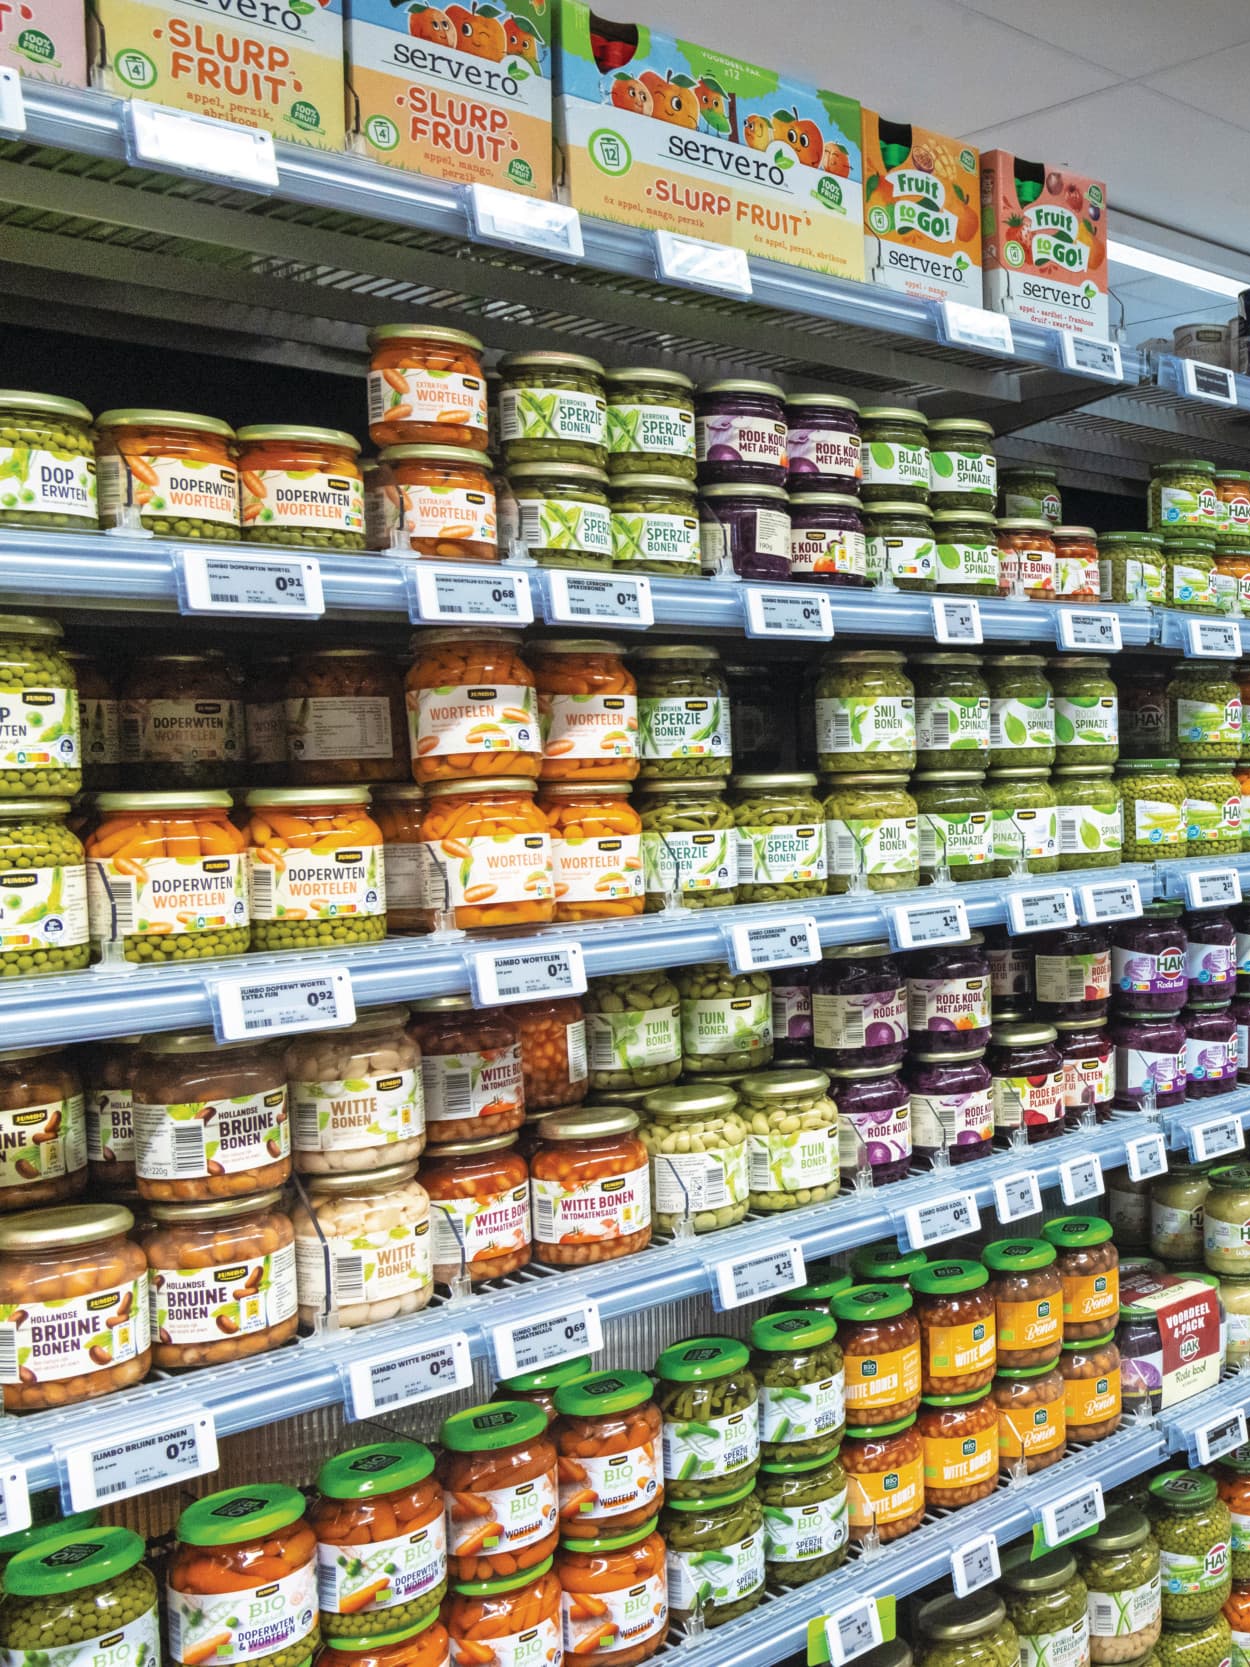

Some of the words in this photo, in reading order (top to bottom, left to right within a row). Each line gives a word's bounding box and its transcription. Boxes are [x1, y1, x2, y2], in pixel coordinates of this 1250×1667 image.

[169, 18, 290, 73] SLURP
[394, 43, 518, 96] servero
[171, 53, 286, 104] FRUIT
[186, 91, 225, 109] appel,
[230, 102, 274, 121] perzik,
[409, 87, 508, 133] SLURP
[411, 117, 505, 162] FRUIT
[669, 136, 784, 186] servero
[897, 173, 938, 199] Fruit
[656, 179, 731, 216] SLURP
[736, 201, 802, 236] FRUIT
[917, 212, 950, 237] GO!
[1035, 208, 1073, 231] Fruit
[1052, 243, 1083, 267] GO!
[889, 250, 963, 282] servero
[1023, 281, 1091, 310] servero
[416, 389, 474, 407] WORTELEN
[559, 406, 602, 425] SPERZIE
[560, 420, 591, 434] BONEN
[642, 420, 687, 438] SPERZIE
[643, 434, 674, 447] BONEN
[738, 429, 762, 445] RODE
[763, 432, 785, 449] KOOL
[816, 441, 837, 457] RODE
[839, 445, 861, 460] KOOL
[898, 450, 923, 465] BLAD
[957, 458, 983, 473] BLAD
[41, 465, 74, 486] DOP
[957, 470, 991, 486] SPINAZIE
[41, 483, 87, 502] ERWTEN
[169, 477, 236, 499] DOPERWTEN
[170, 490, 232, 513] WORTELEN
[276, 488, 350, 507] DOPERWTEN
[276, 502, 342, 519] WORTELEN
[419, 505, 478, 522] WORTELEN
[647, 527, 691, 544] SPERZIE
[647, 540, 678, 553] BONEN
[964, 550, 988, 564] BLAD
[964, 561, 996, 576] SPINAZIE
[430, 704, 495, 721] WORTELEN
[566, 711, 623, 727] WORTELEN
[654, 712, 701, 726] SPERZIE
[874, 705, 896, 719] SNIJ
[960, 707, 982, 719] BLAD
[153, 717, 224, 729] DOPERWTEN
[654, 725, 686, 737] BONEN
[874, 717, 903, 730] BONEN
[1075, 718, 1109, 729] SPINAZIE
[948, 823, 975, 837] BLAD
[767, 838, 809, 852] SPERZIE
[948, 833, 983, 847] SPINAZIE
[487, 852, 543, 869] WORTELEN
[659, 846, 708, 859] SPERZIE
[768, 852, 797, 863] BONEN
[560, 855, 620, 870] WORTELEN
[288, 866, 365, 882] DOPERWTEN
[152, 876, 233, 893] DOPERWTEN
[289, 882, 357, 897] WORTELEN
[153, 892, 225, 909] WORTELEN
[494, 958, 519, 968] JUMBO
[521, 954, 560, 966] WORTELEN
[936, 993, 959, 1006] RODE
[960, 992, 982, 1003] KOOL
[698, 1011, 726, 1025] TUIN
[646, 1020, 670, 1035] TUIN
[698, 1023, 728, 1036] BONEN
[646, 1032, 672, 1047] BONEN
[218, 1106, 259, 1120] HOLLANDSE
[330, 1097, 377, 1115] WITTE
[219, 1112, 273, 1138] BRUINE
[332, 1113, 372, 1129] BONEN
[220, 1132, 261, 1151] BONEN
[800, 1141, 825, 1158] TUIN
[801, 1155, 827, 1169] BONEN
[560, 1195, 596, 1212] WITTE
[599, 1190, 634, 1208] BONEN
[377, 1244, 416, 1266] WITTE
[217, 1268, 246, 1280] JUMBO
[377, 1261, 412, 1279] BONEN
[166, 1280, 206, 1289] HOLLANDSE
[167, 1287, 227, 1307] BRUINE
[30, 1310, 78, 1324] HOLLANDSE
[168, 1306, 208, 1321] BONEN
[1166, 1302, 1211, 1329] VOORDEEL
[31, 1315, 101, 1343] BRUINE
[1173, 1318, 1205, 1339] 4-PACK
[32, 1338, 81, 1358] BONEN
[1180, 1337, 1200, 1356] HAK
[371, 1364, 396, 1376] JUMBO
[398, 1357, 416, 1369] WITTE
[418, 1350, 445, 1363] BONEN
[724, 1422, 748, 1440] BIO
[92, 1445, 123, 1462] JUMBO
[124, 1437, 156, 1454] BRUINE
[158, 1428, 188, 1444] BONEN
[603, 1465, 633, 1484] BIO
[510, 1492, 539, 1514] BIO
[599, 1490, 638, 1507] WORTELEN
[505, 1519, 543, 1539] WORTELEN
[797, 1514, 823, 1530] BIO
[404, 1540, 432, 1562] BIO
[796, 1536, 824, 1550] SPERZIE
[1205, 1552, 1230, 1571] HAK
[395, 1559, 438, 1586] DOPERWTEN
[249, 1595, 286, 1619] BIO
[238, 1616, 294, 1642] DOPERWTEN
[93, 1643, 130, 1666] BIO
